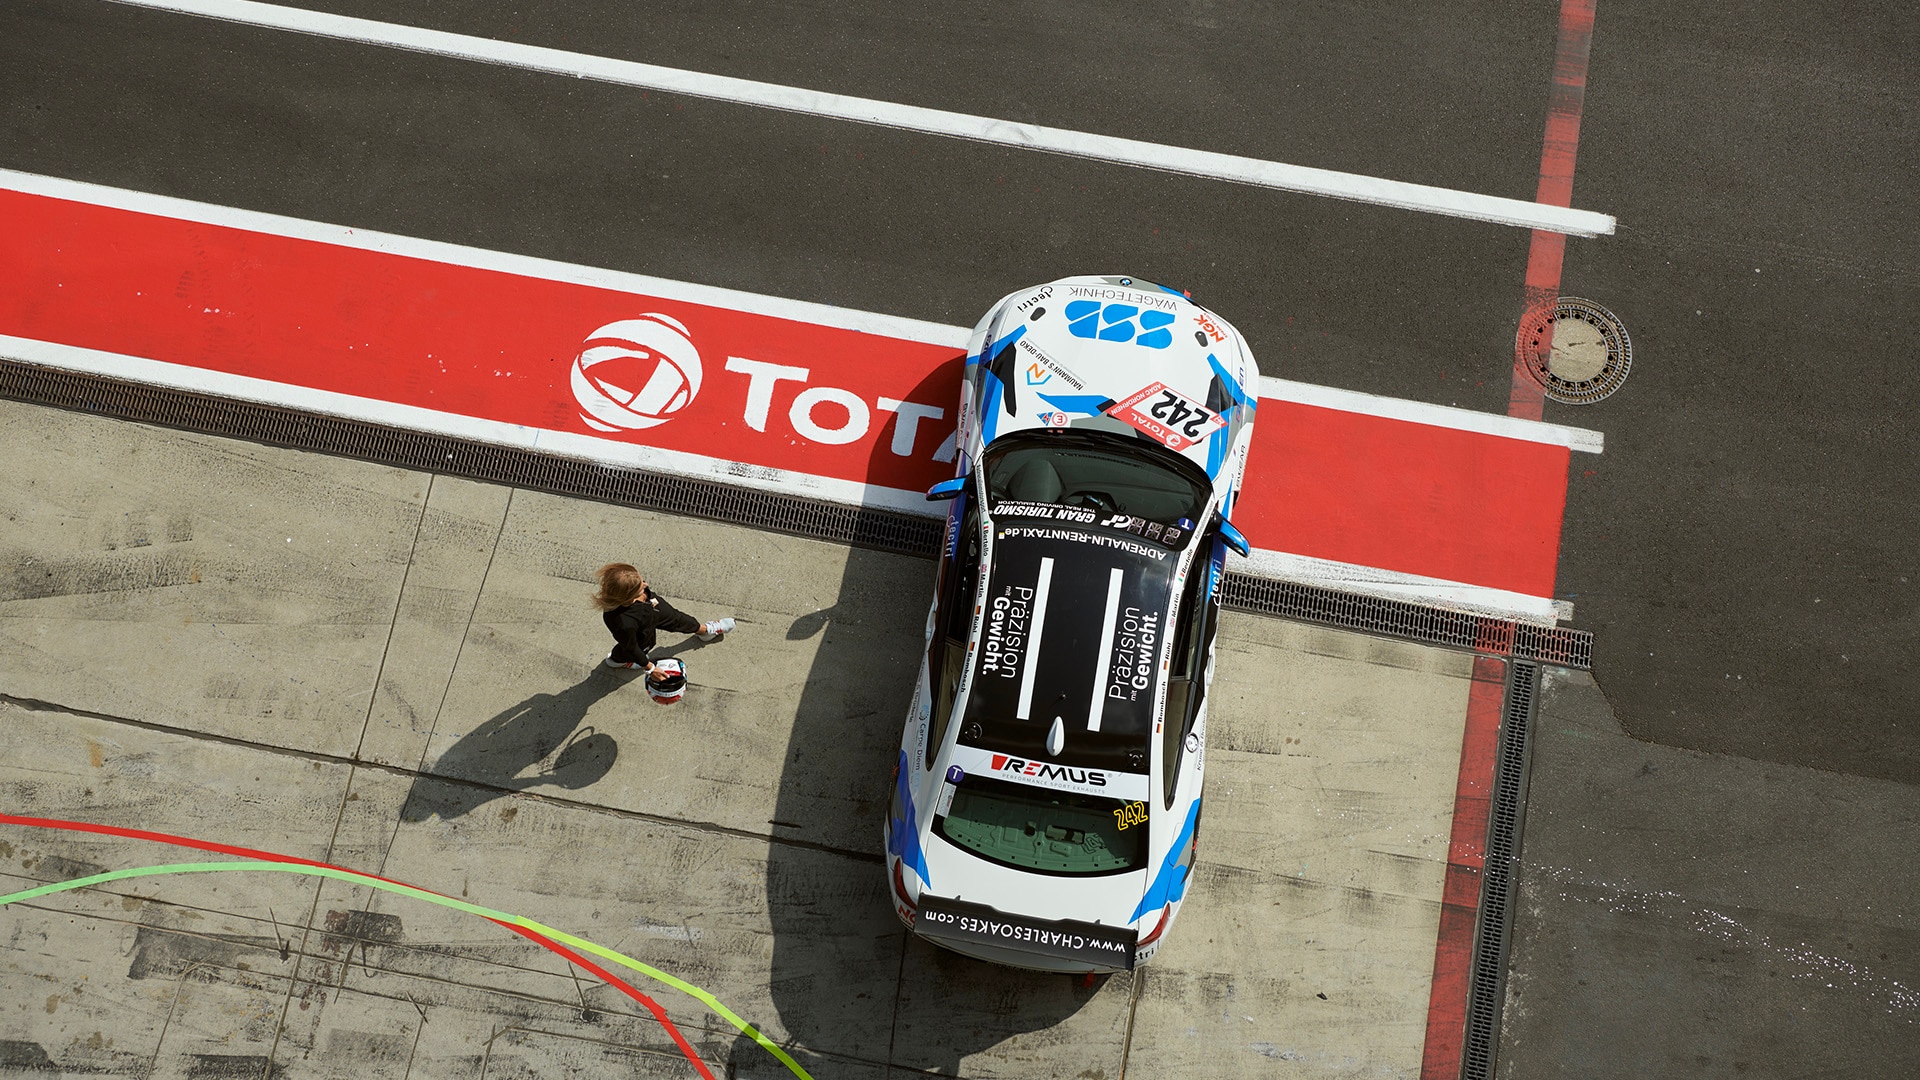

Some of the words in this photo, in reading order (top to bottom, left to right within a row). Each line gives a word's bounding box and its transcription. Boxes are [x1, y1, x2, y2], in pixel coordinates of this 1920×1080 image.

[1069, 287, 1177, 311] WÄGETECHNIK
[1064, 300, 1176, 349] SSB
[1193, 314, 1225, 343] NGK
[1144, 383, 1161, 397] ADAC
[1110, 393, 1146, 415] NORDRHEIN
[1150, 389, 1210, 438] 242
[1131, 411, 1165, 439] TOTAL
[1055, 508, 1096, 524] GRAN
[1082, 506, 1096, 514] THE
[1181, 518, 1190, 530] T
[1004, 527, 1167, 561] ADRENALIN-RENNTAXI.de
[1004, 585, 1012, 597] mit
[1171, 593, 1180, 618] Martin
[982, 596, 1011, 676] Gewicht.
[1000, 586, 1034, 679] Präzision
[1108, 606, 1140, 701] Präzision
[1131, 611, 1159, 691] Gewicht.
[1130, 689, 1138, 702] mit
[916, 723, 927, 748] Carpe
[952, 766, 962, 780] T
[1001, 773, 1049, 787] PERFORMANCE
[1050, 780, 1071, 790] SPORT
[1072, 785, 1106, 795] EXHAUSTS
[1003, 758, 1107, 787] REMUS
[1113, 801, 1149, 831] 242
[924, 910, 1126, 953] www.CHARLESOAKES.com
